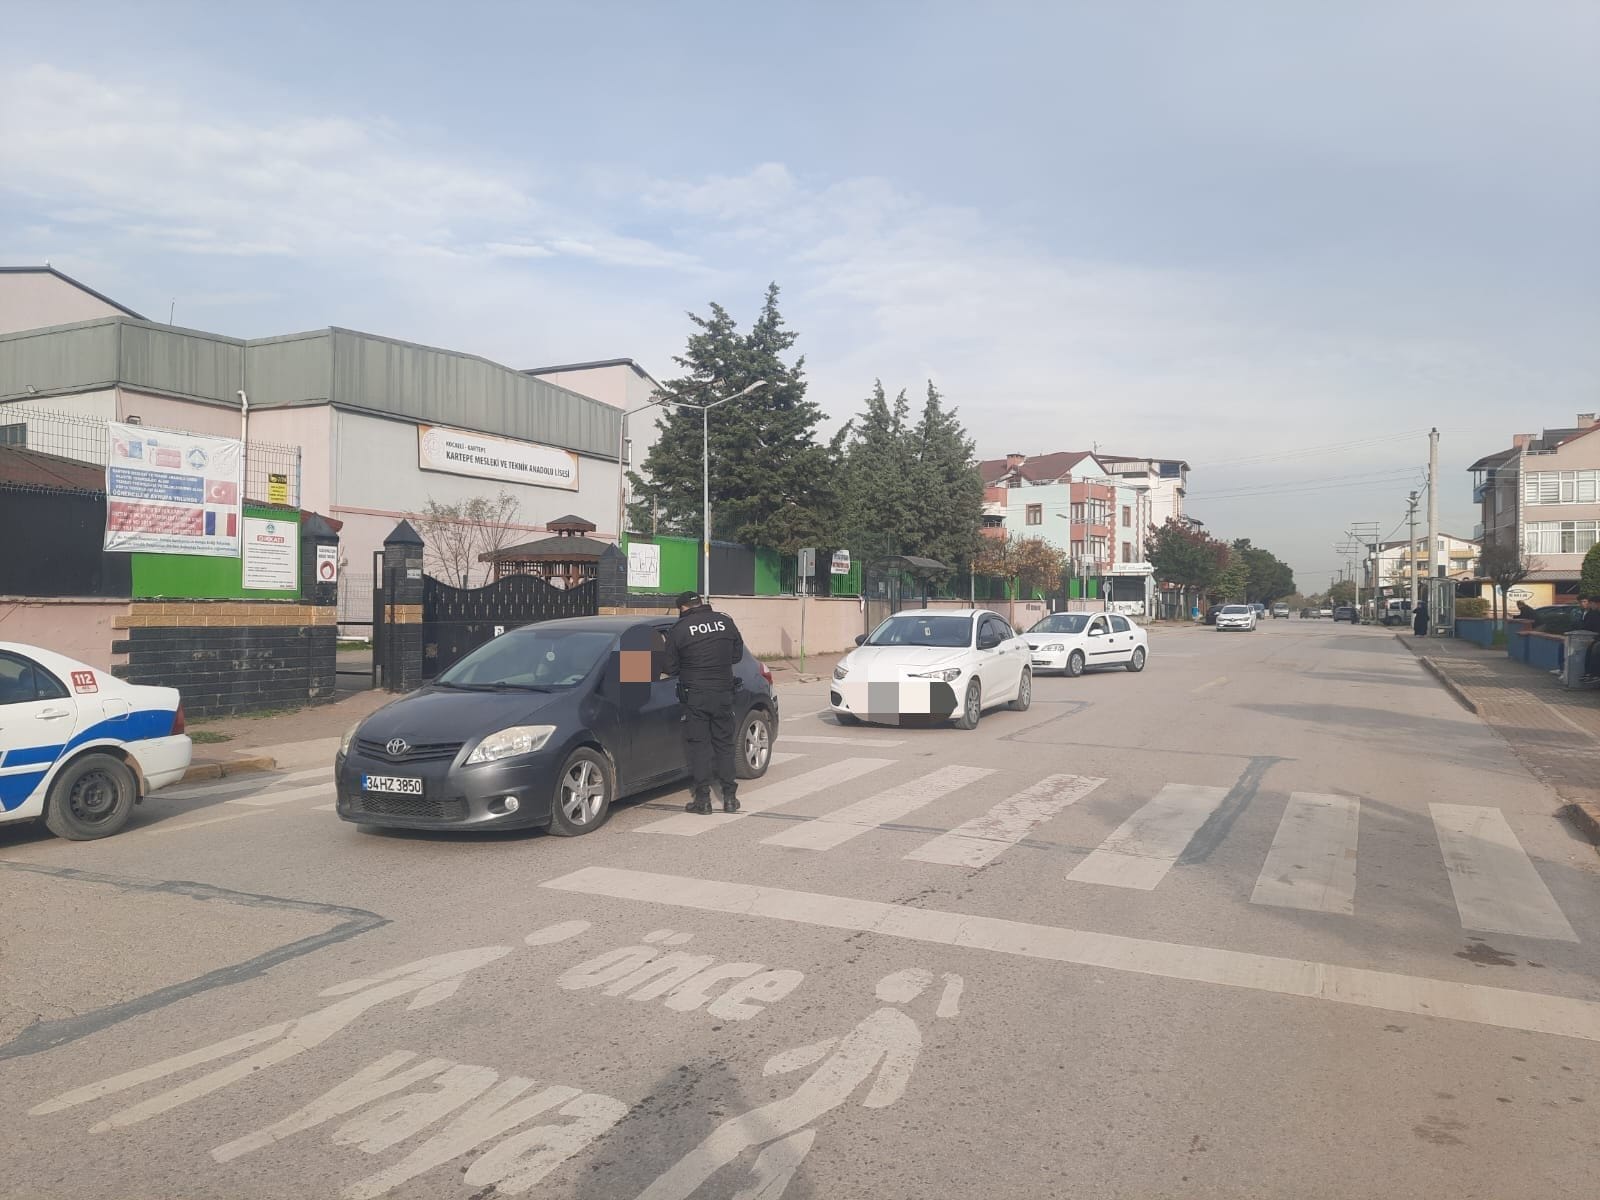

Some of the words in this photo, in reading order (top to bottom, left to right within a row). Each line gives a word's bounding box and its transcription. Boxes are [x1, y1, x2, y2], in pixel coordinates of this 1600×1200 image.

[446, 450, 473, 463] KARTEPE
[500, 460, 508, 469] VE
[508, 460, 529, 471] TEKNİK
[529, 464, 554, 475] ANADOLU
[74, 674, 94, 685] 112
[396, 779, 421, 792] 3850
